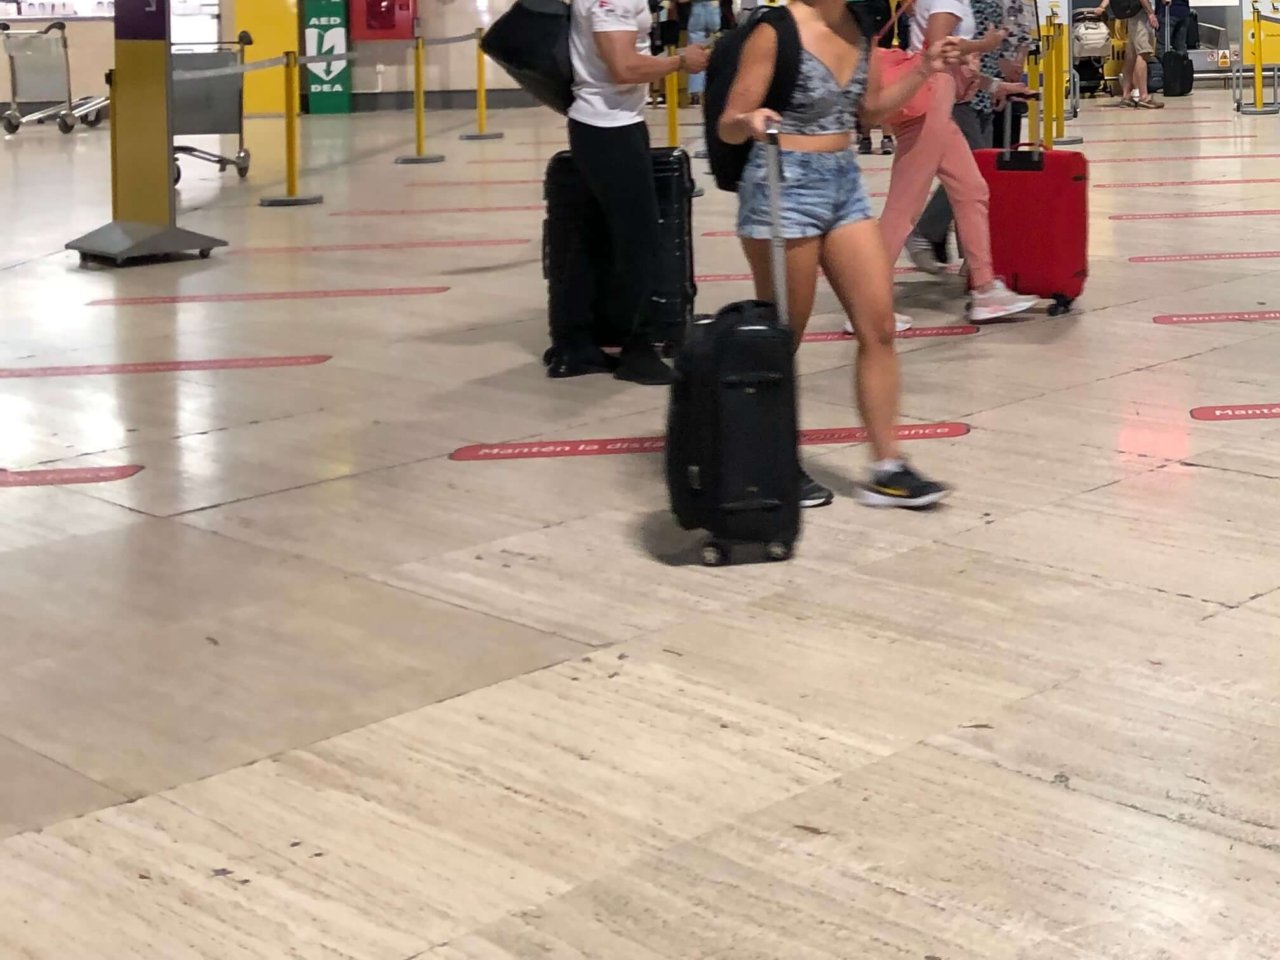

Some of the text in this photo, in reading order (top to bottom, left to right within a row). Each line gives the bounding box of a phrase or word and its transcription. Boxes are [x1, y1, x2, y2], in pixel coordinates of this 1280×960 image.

[309, 17, 341, 25] AED
[310, 83, 343, 92] DEA
[478, 445, 571, 456] Mantén
[606, 441, 665, 450] dista
